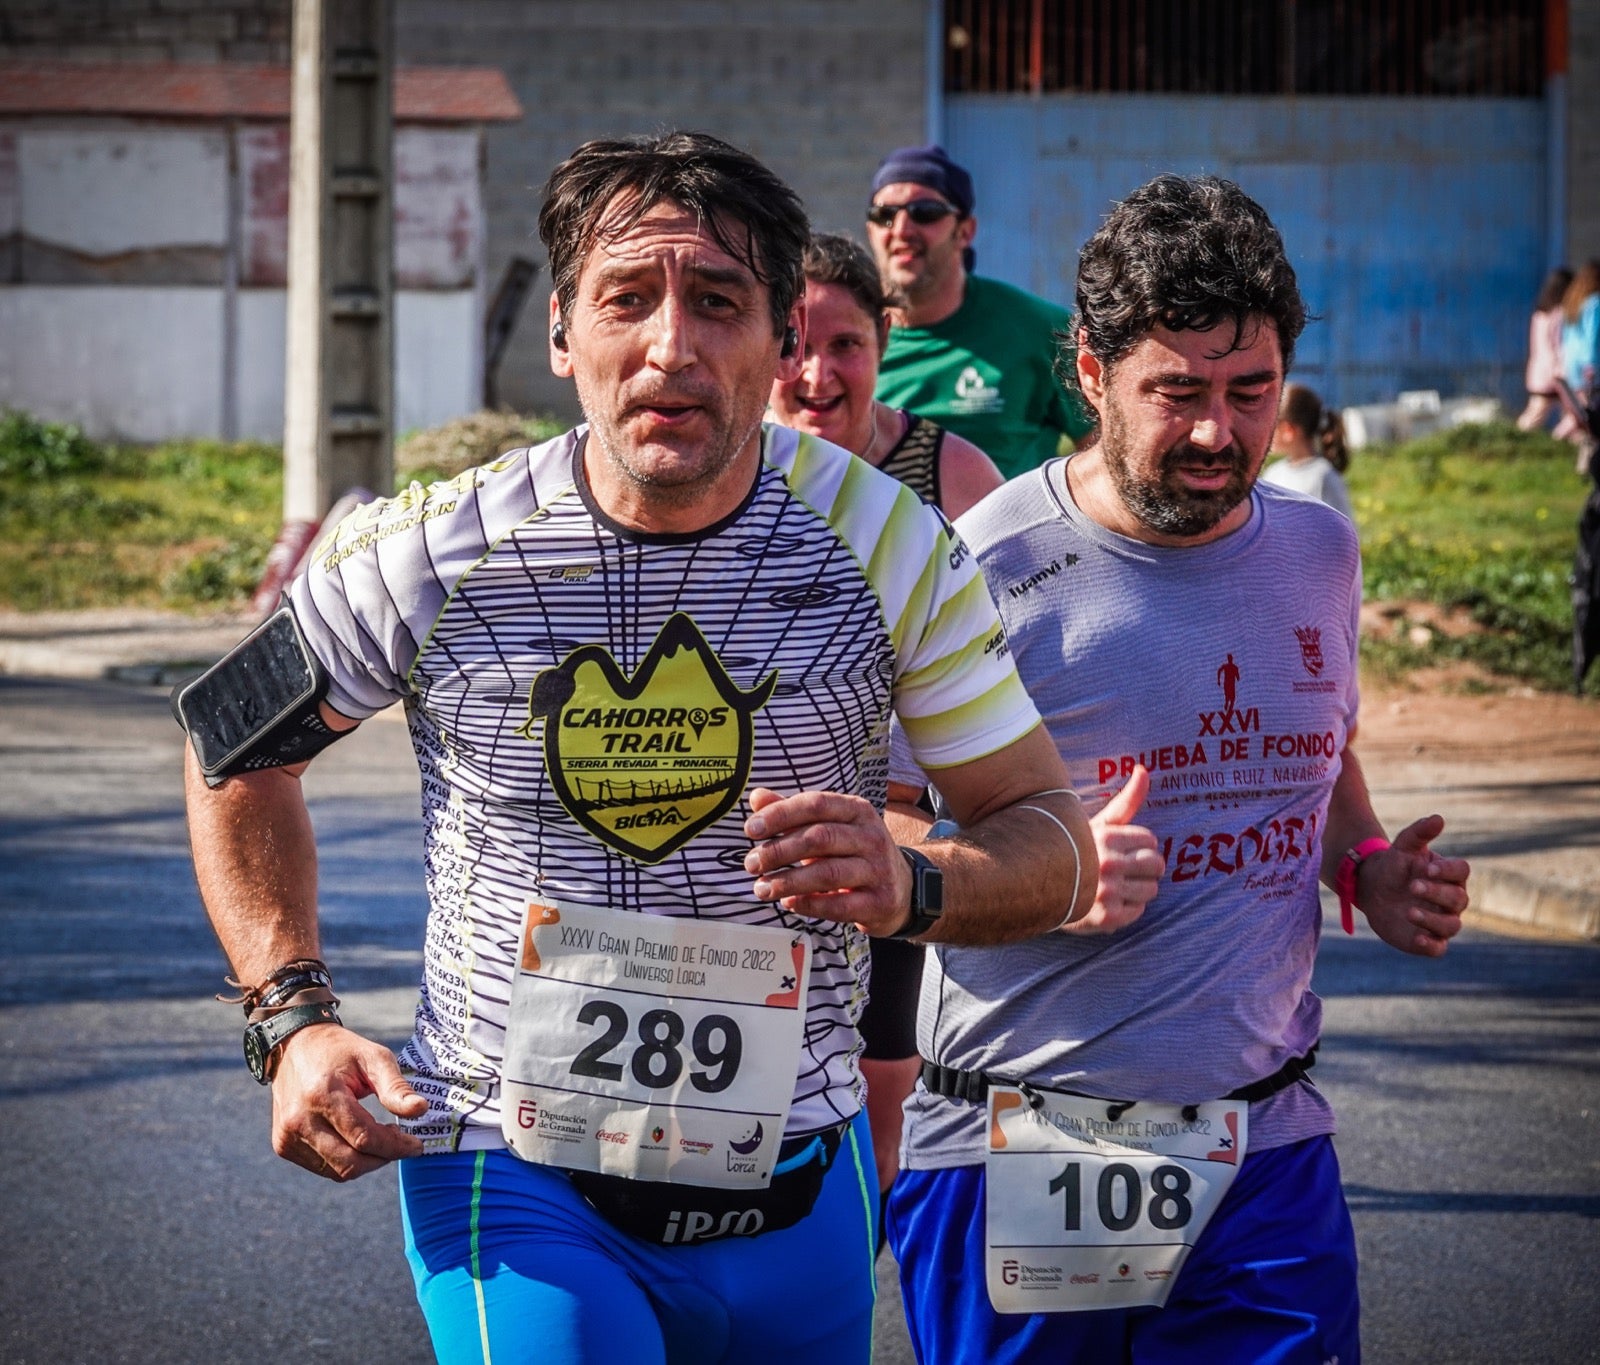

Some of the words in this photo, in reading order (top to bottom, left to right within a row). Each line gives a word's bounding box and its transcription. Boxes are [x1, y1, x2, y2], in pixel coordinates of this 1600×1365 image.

[1009, 560, 1061, 598] luanvi
[1198, 708, 1260, 737] XXVI
[567, 760, 608, 768] SIERRA
[613, 760, 657, 768] NEVADA
[673, 759, 730, 768] MONACHIL
[1098, 742, 1207, 785] PRUEBA
[1220, 738, 1249, 762] DE
[1263, 731, 1335, 759] FONDO
[1160, 771, 1225, 791] ANTONIO
[1233, 768, 1265, 785] RUIZ
[560, 926, 594, 949] XXXV
[742, 949, 776, 972] 2022
[569, 1000, 743, 1093] 289
[538, 1120, 548, 1130] de
[549, 1122, 586, 1134] Granada
[540, 1109, 587, 1124] Diputación
[1049, 1162, 1192, 1231] 108
